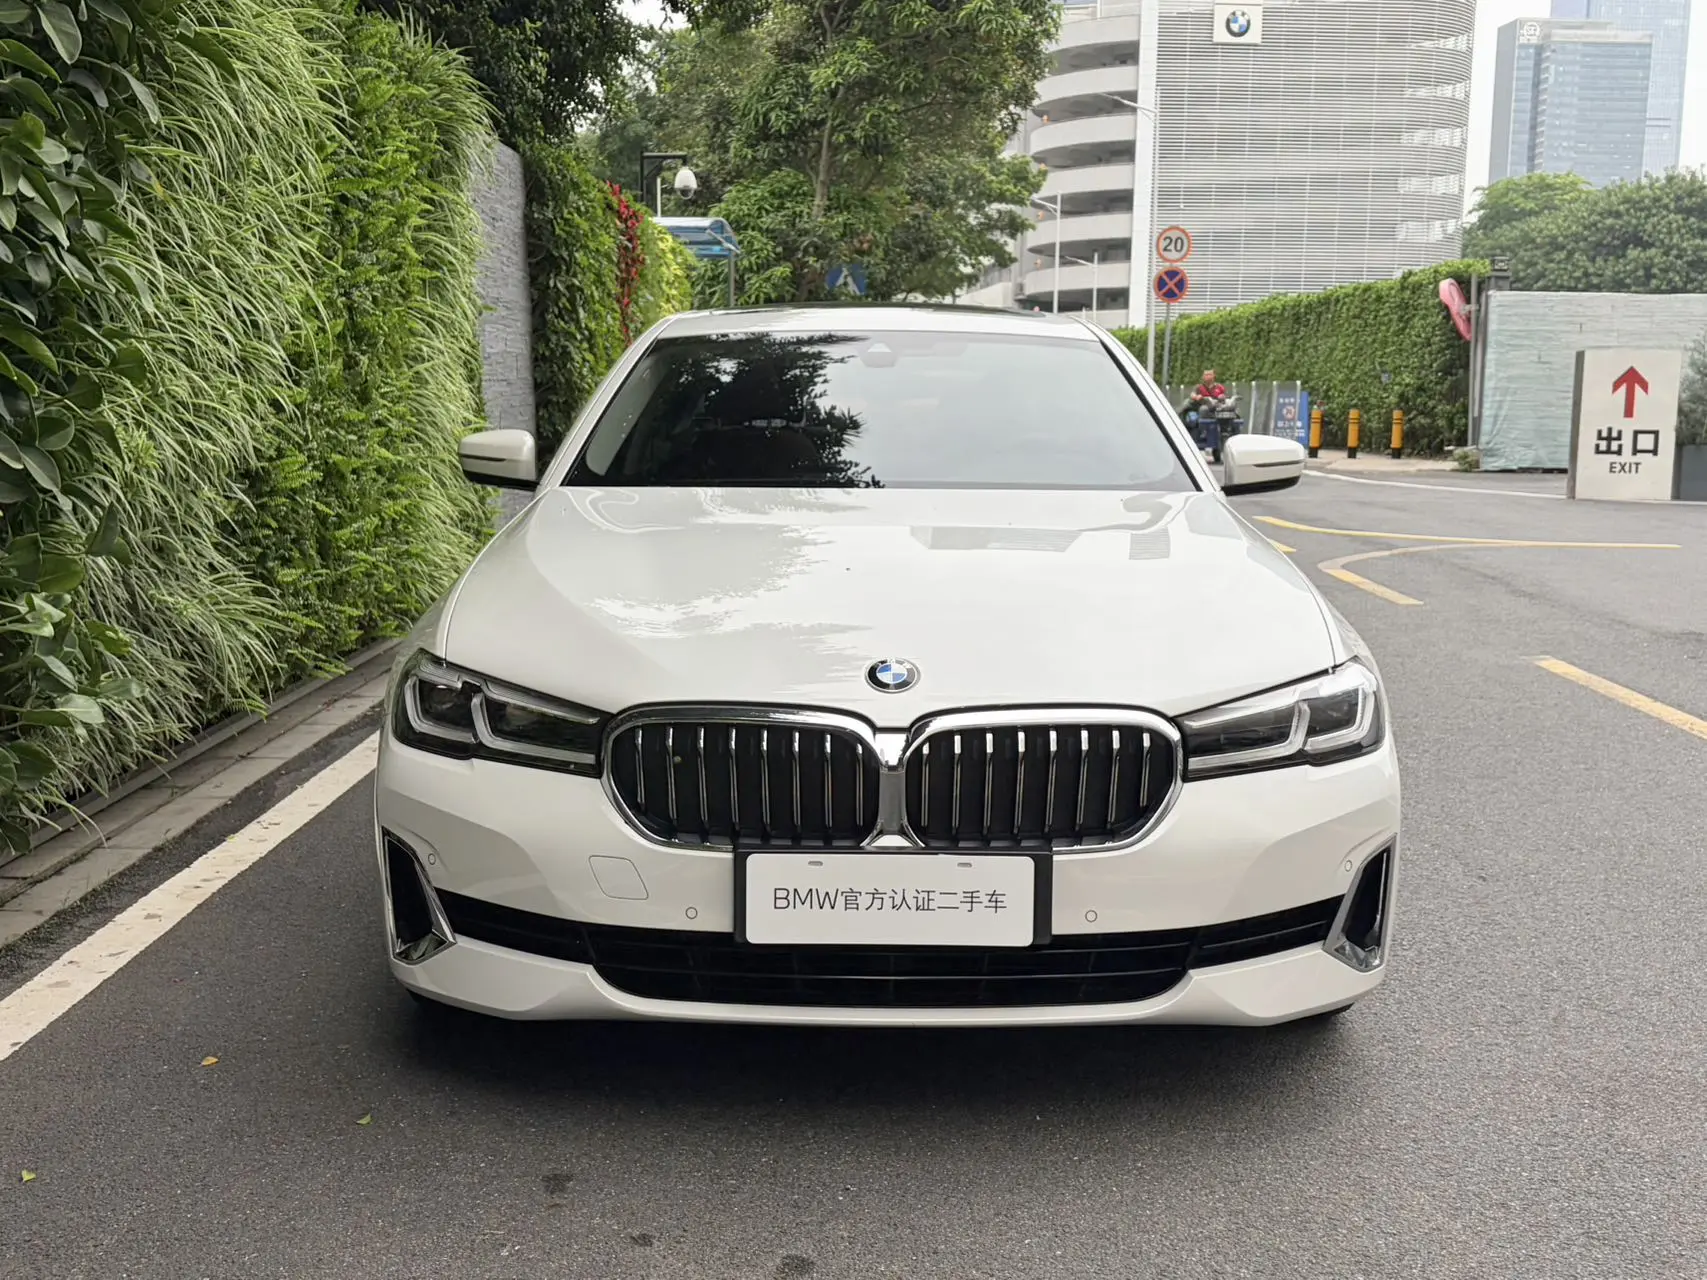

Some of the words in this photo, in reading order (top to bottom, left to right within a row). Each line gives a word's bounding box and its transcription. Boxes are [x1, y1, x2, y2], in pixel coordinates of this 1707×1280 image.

[1163, 236, 1185, 253] 20
[1594, 426, 1660, 457] 出口
[1609, 461, 1642, 474] EXIT
[773, 887, 1008, 914] BMW官方认证二手车
